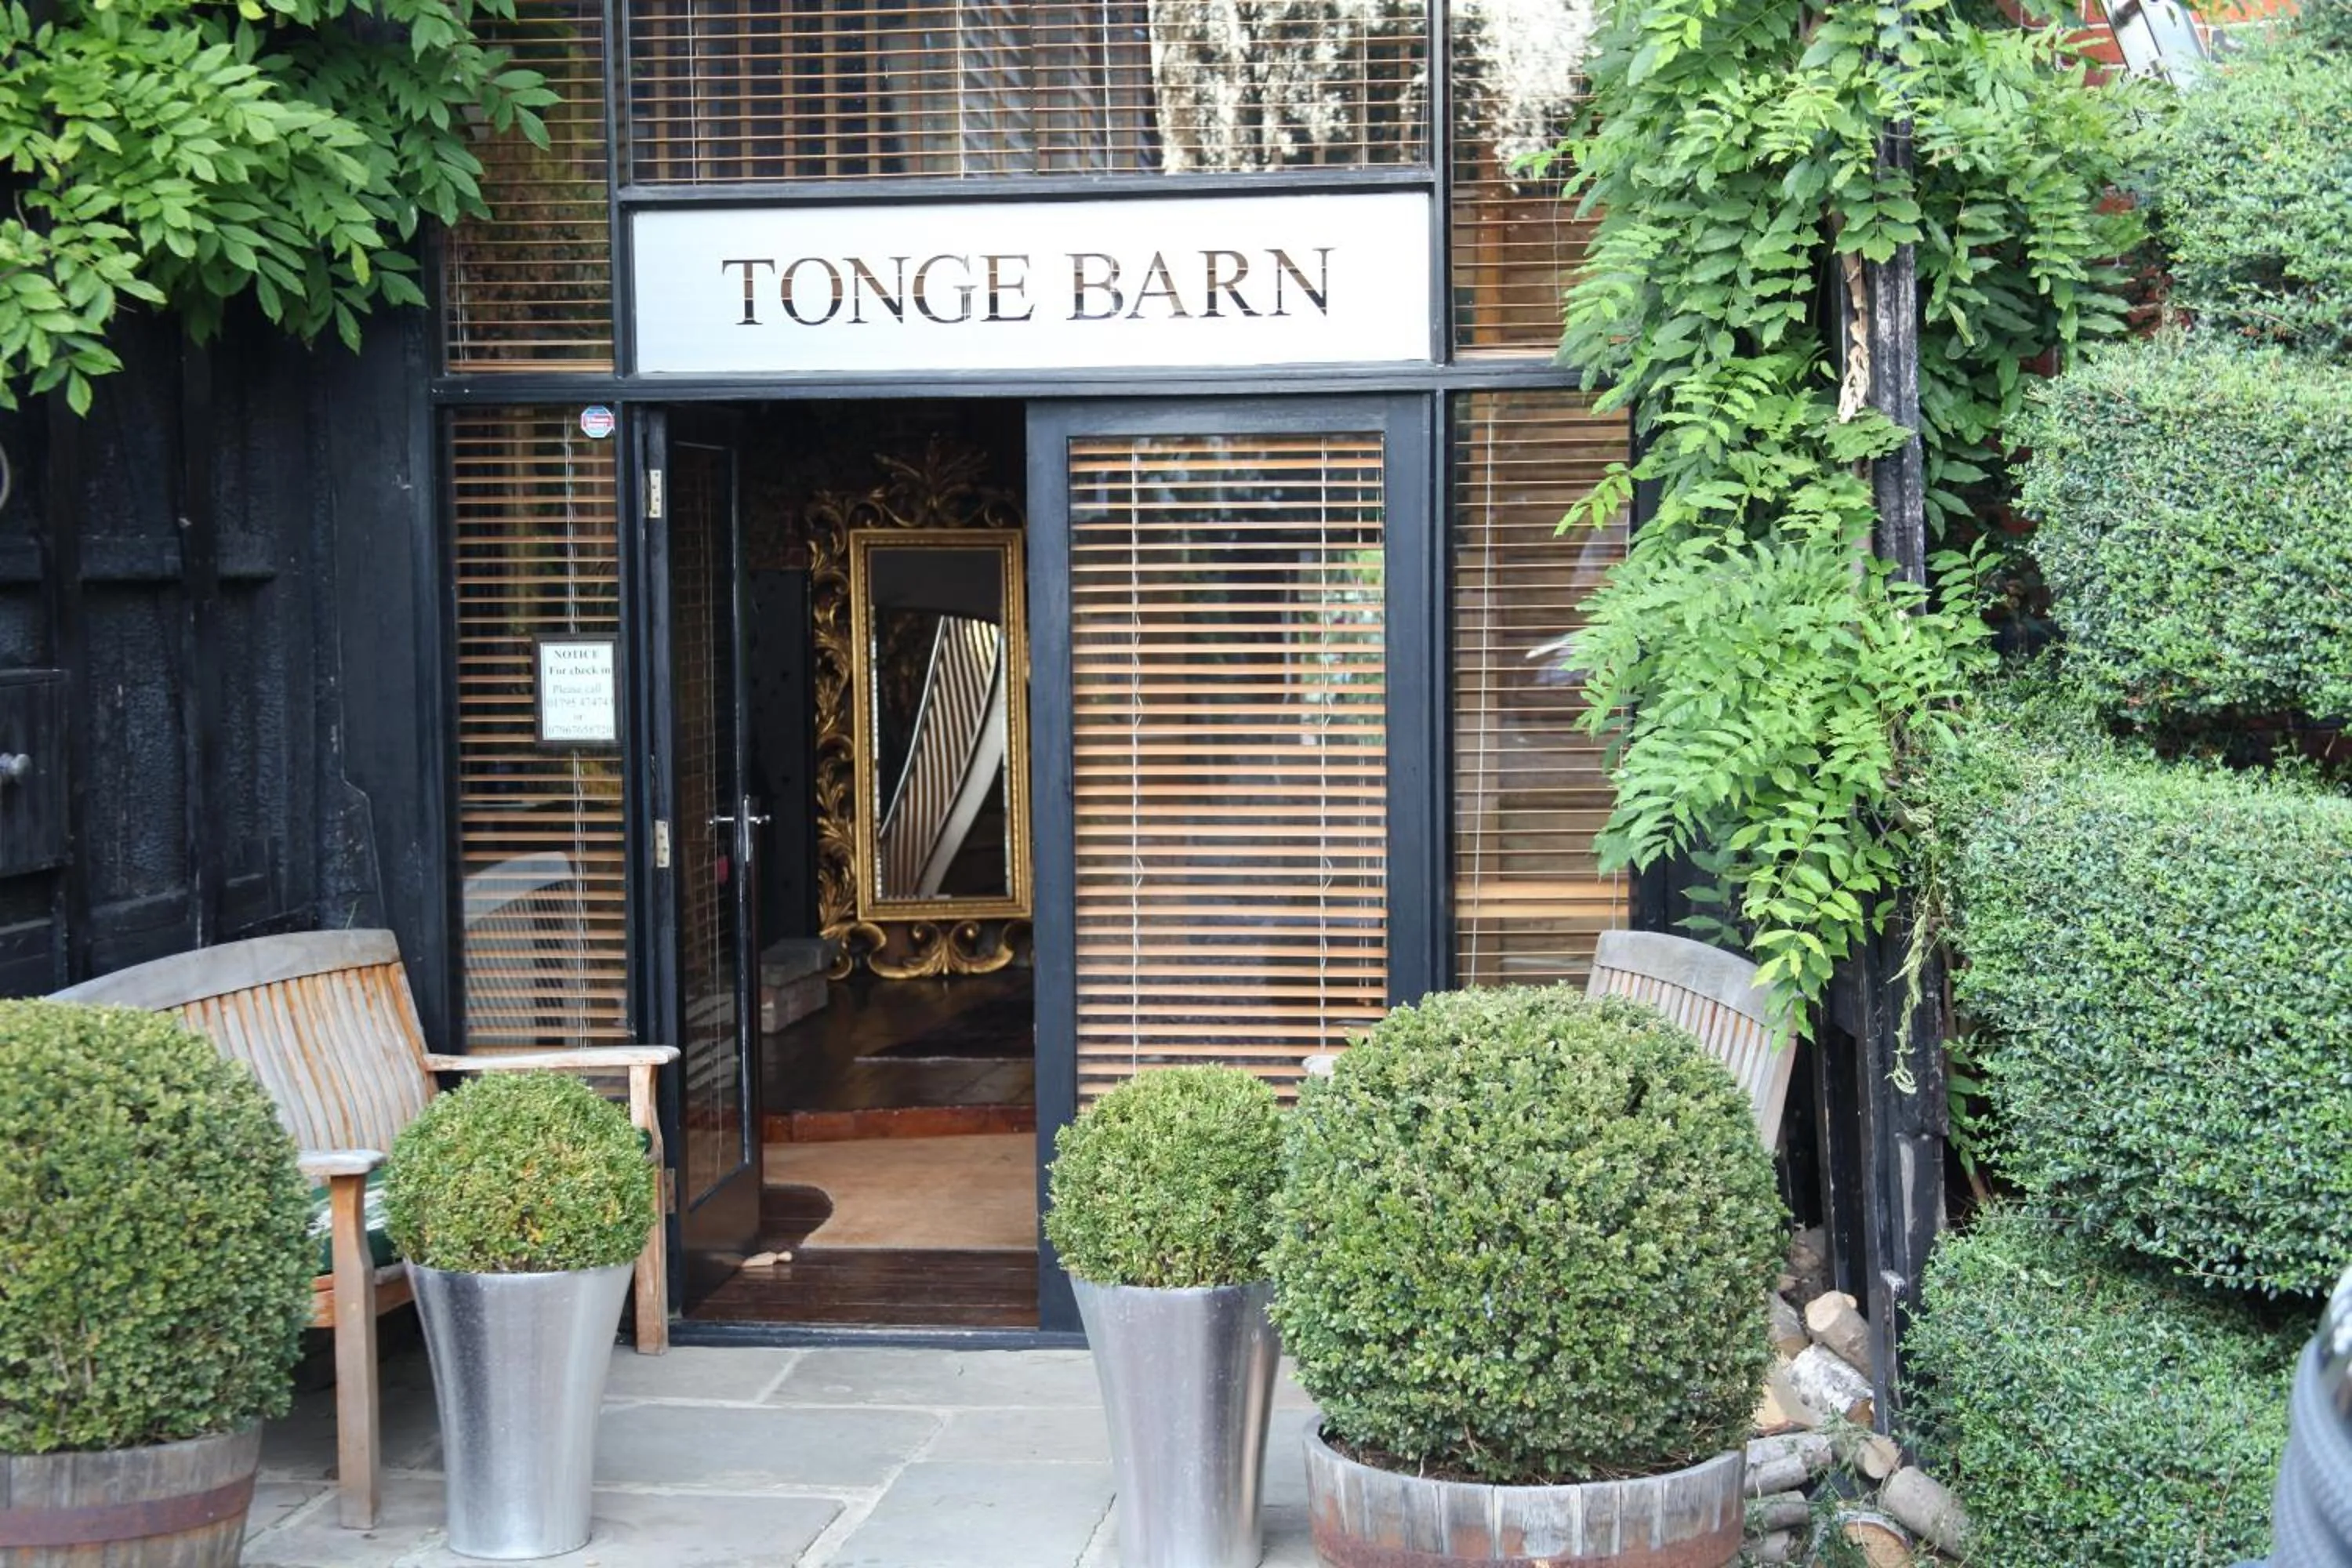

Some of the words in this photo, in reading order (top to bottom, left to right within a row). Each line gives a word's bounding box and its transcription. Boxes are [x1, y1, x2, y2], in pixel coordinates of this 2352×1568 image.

[722, 255, 1035, 326] TONGE
[1064, 248, 1335, 320] BARN
[554, 649, 598, 659] NOTICE
[549, 666, 566, 676] For
[569, 666, 598, 676] check
[553, 684, 583, 695] Please
